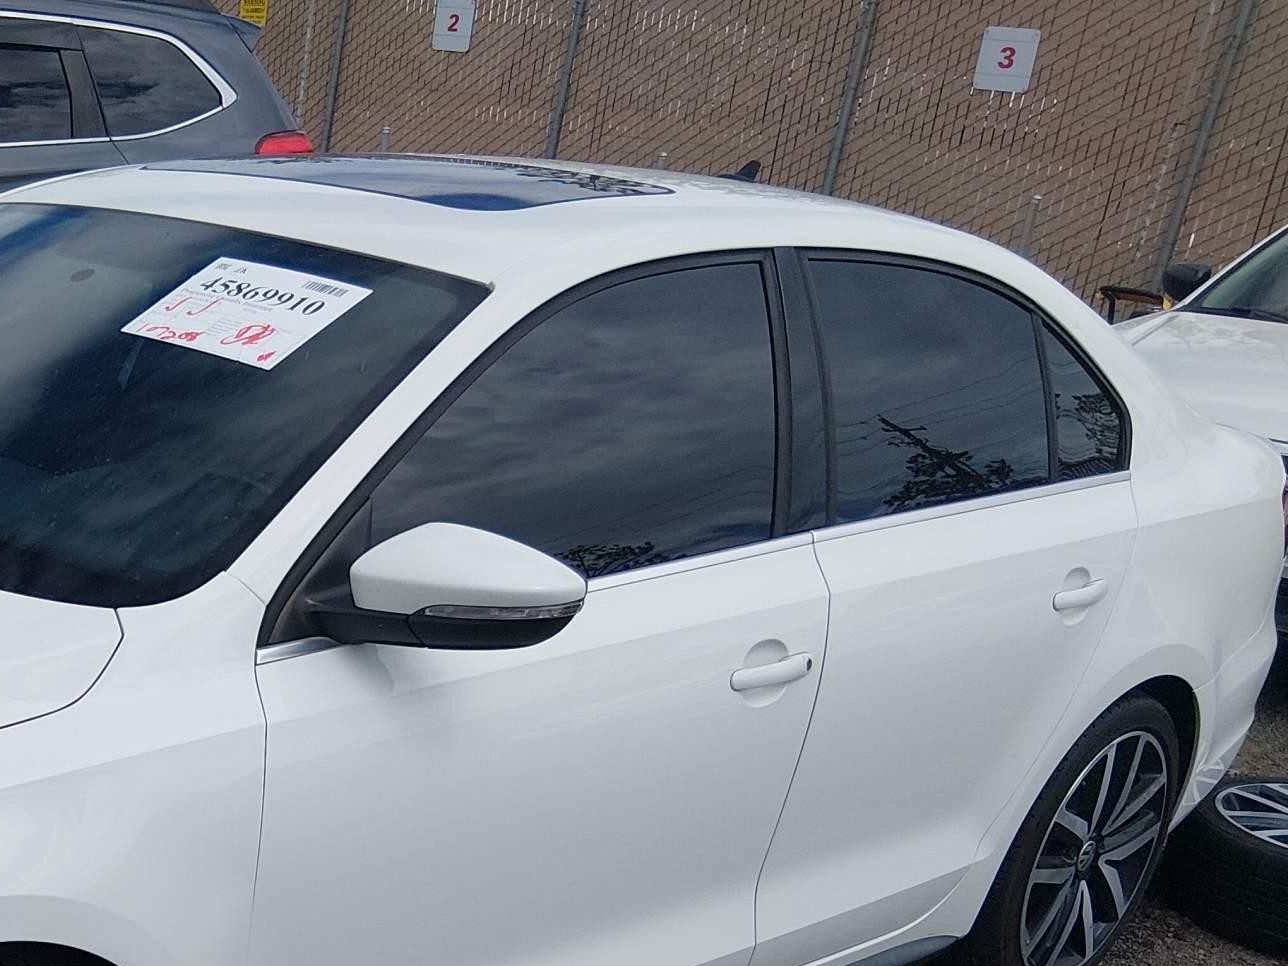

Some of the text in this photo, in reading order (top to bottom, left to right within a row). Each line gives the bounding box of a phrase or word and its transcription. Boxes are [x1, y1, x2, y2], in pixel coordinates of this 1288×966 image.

[447, 14, 460, 32] 2
[997, 46, 1016, 69] 3
[200, 276, 326, 316] 45869910
